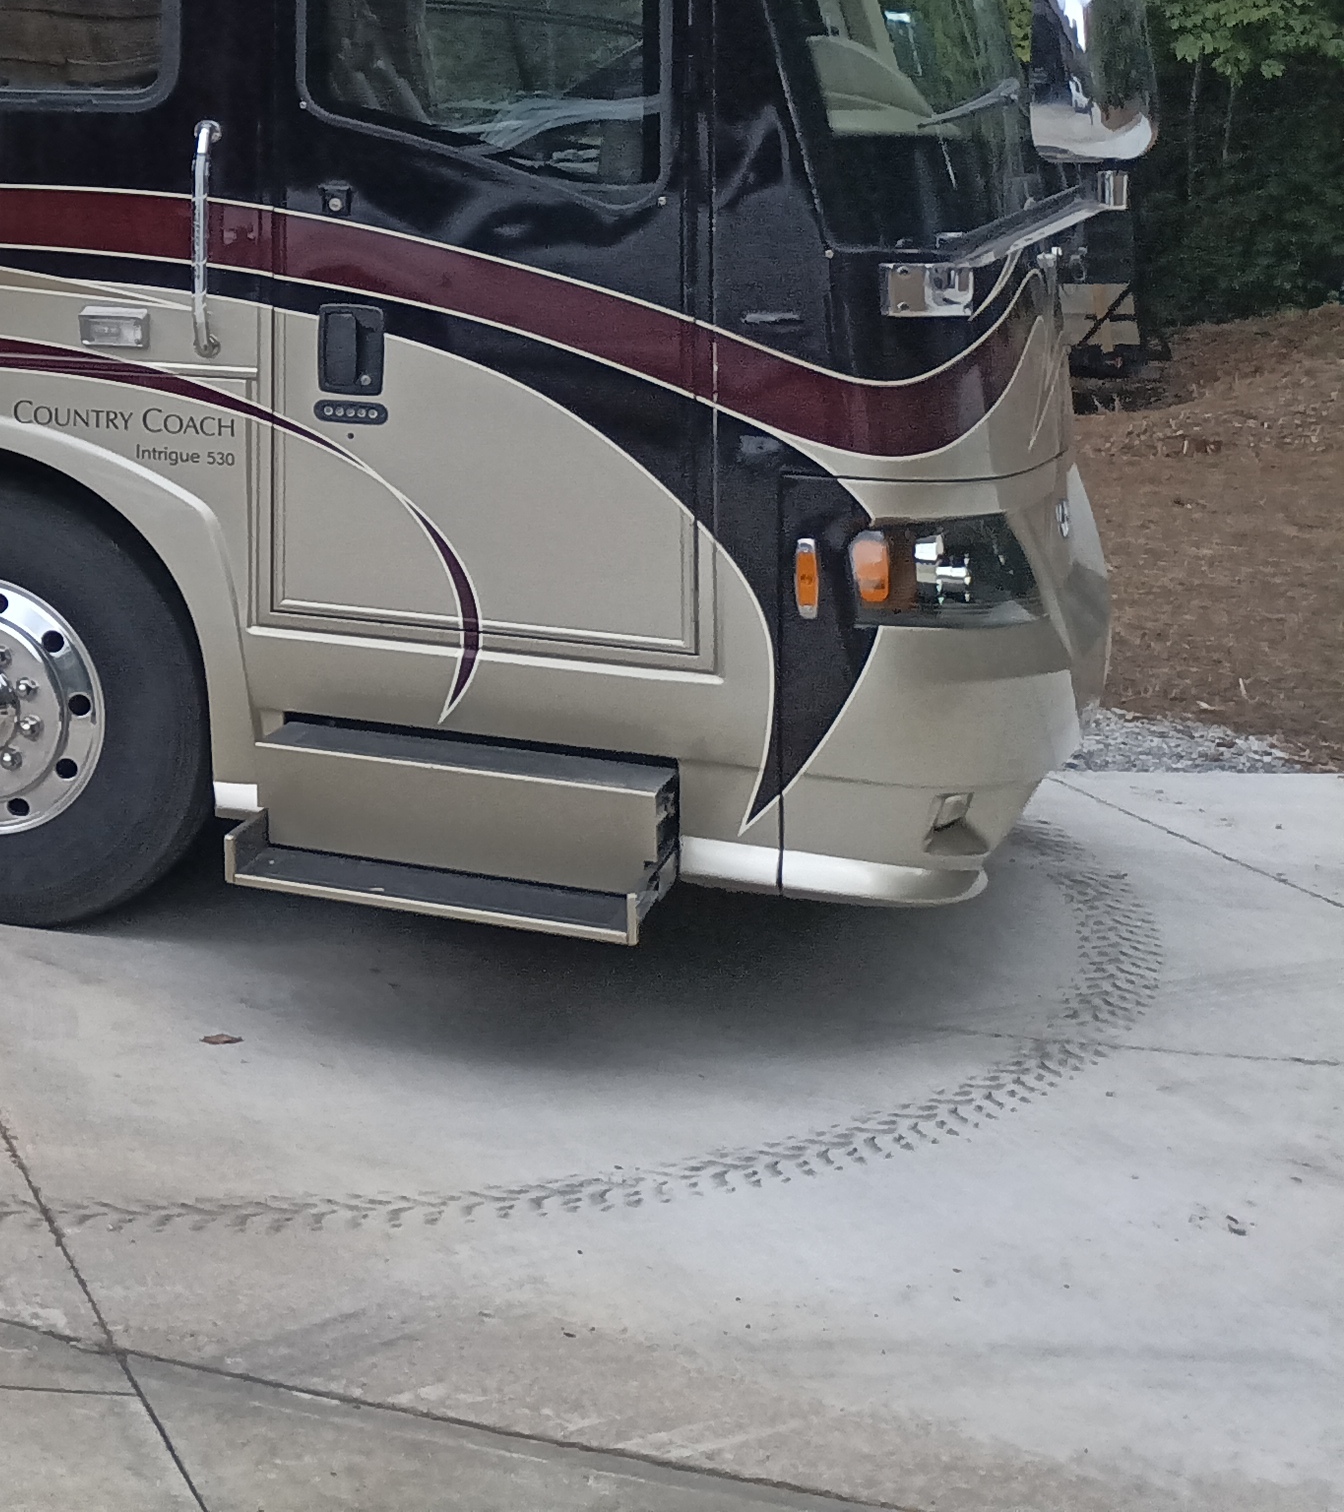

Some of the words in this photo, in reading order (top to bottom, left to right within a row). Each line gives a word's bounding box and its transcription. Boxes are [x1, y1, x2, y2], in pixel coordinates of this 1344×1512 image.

[13, 399, 133, 431] COUNTRY
[142, 407, 235, 437] COACH
[136, 443, 200, 466] Intrigue
[206, 451, 235, 467] 530
